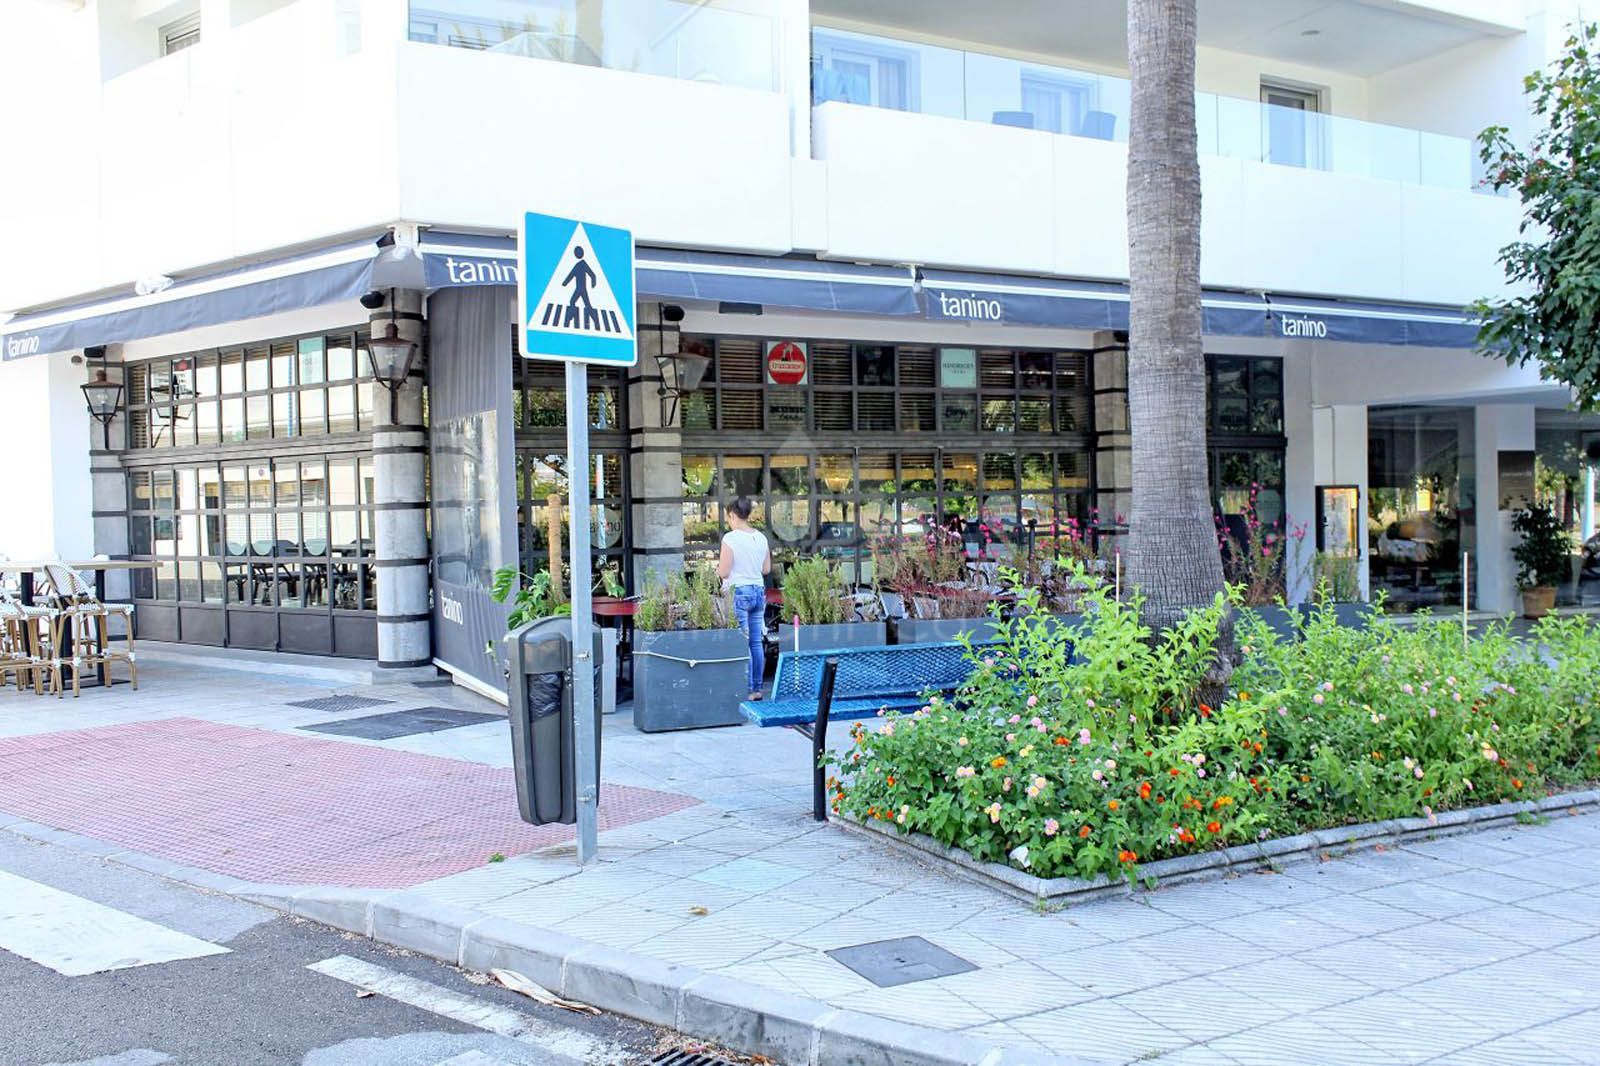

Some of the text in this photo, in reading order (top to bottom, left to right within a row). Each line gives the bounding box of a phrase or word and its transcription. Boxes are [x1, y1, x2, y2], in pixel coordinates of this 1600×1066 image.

[446, 256, 517, 284] tanin
[940, 292, 1001, 320] tanino
[1282, 313, 1327, 338] tanino
[7, 332, 40, 357] tanino
[440, 591, 464, 625] tanino
